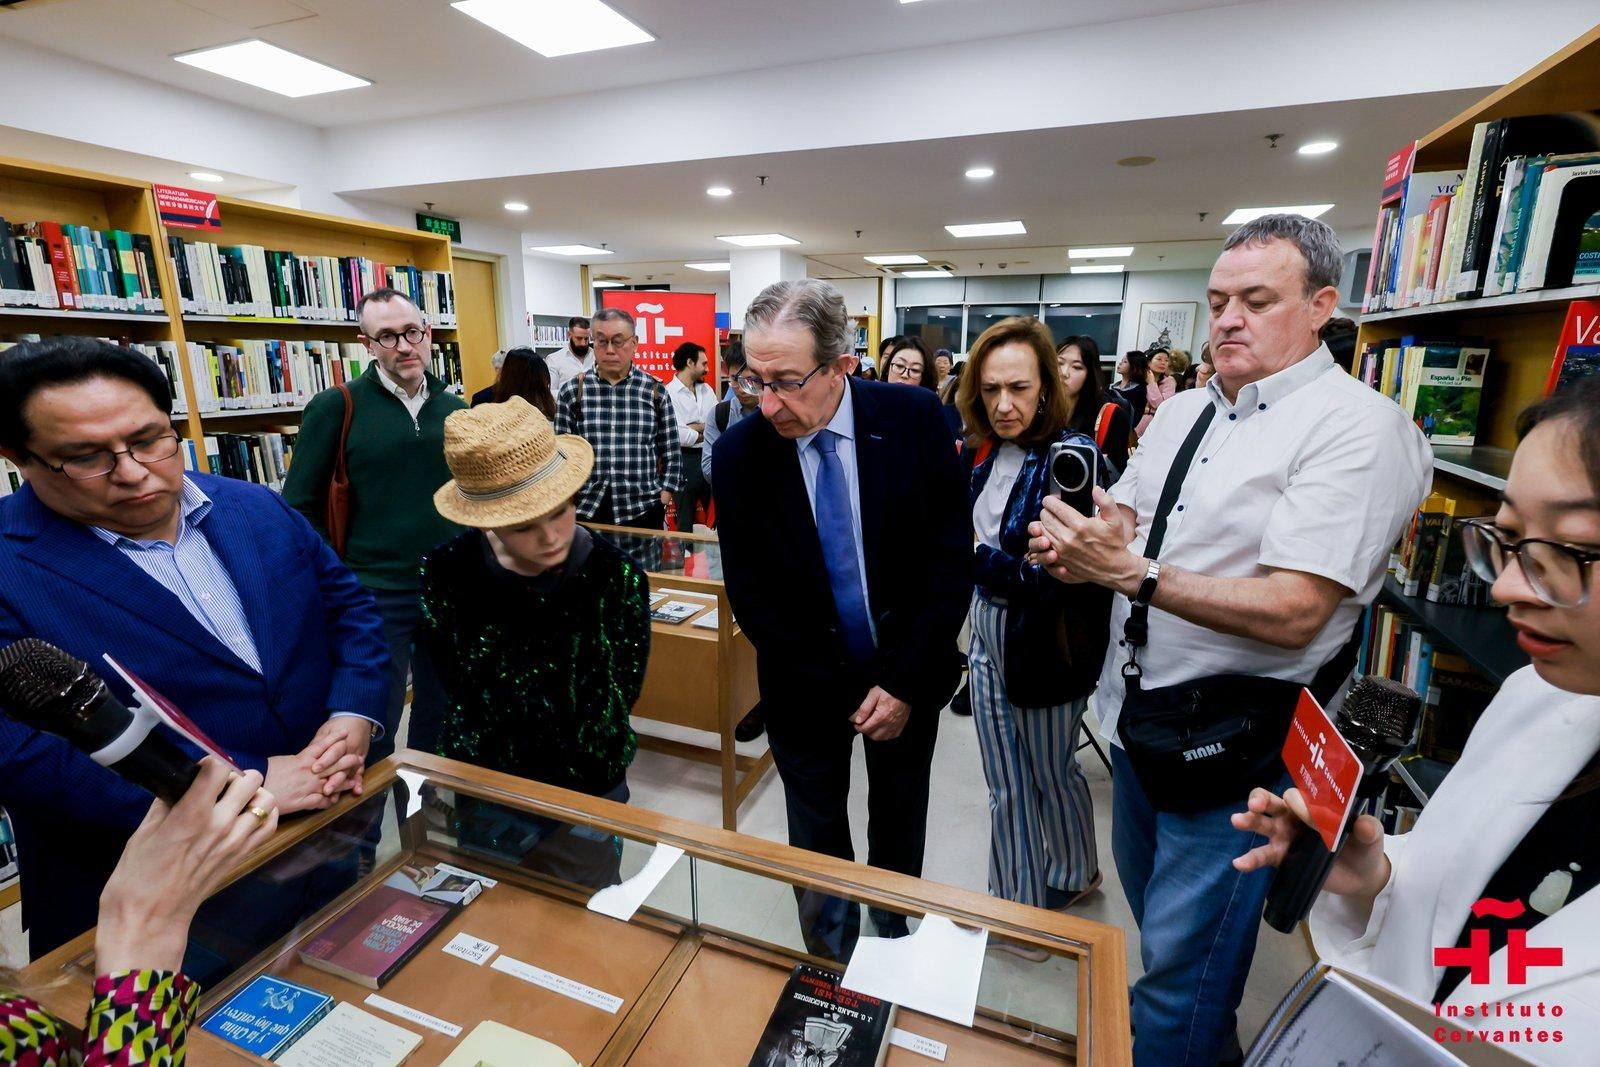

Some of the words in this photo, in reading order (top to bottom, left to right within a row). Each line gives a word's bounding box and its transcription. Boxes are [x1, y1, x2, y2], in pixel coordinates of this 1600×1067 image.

[1478, 160, 1489, 195] PLANETA
[156, 188, 189, 197] LITERATURA
[157, 194, 208, 206] HISPANOAMERICANA
[425, 217, 455, 231] 安全出口
[1430, 374, 1455, 382] España
[1183, 742, 1226, 761] THULE
[381, 918, 417, 935] MARCELA
[391, 914, 412, 925] JUAN
[409, 921, 423, 929] DE
[450, 943, 483, 961] Escritora
[472, 942, 491, 953] 作家
[793, 992, 829, 1008] BACKHOUSE
[218, 1007, 256, 1024] entreví
[219, 1021, 249, 1040] China
[270, 1023, 290, 1036] que
